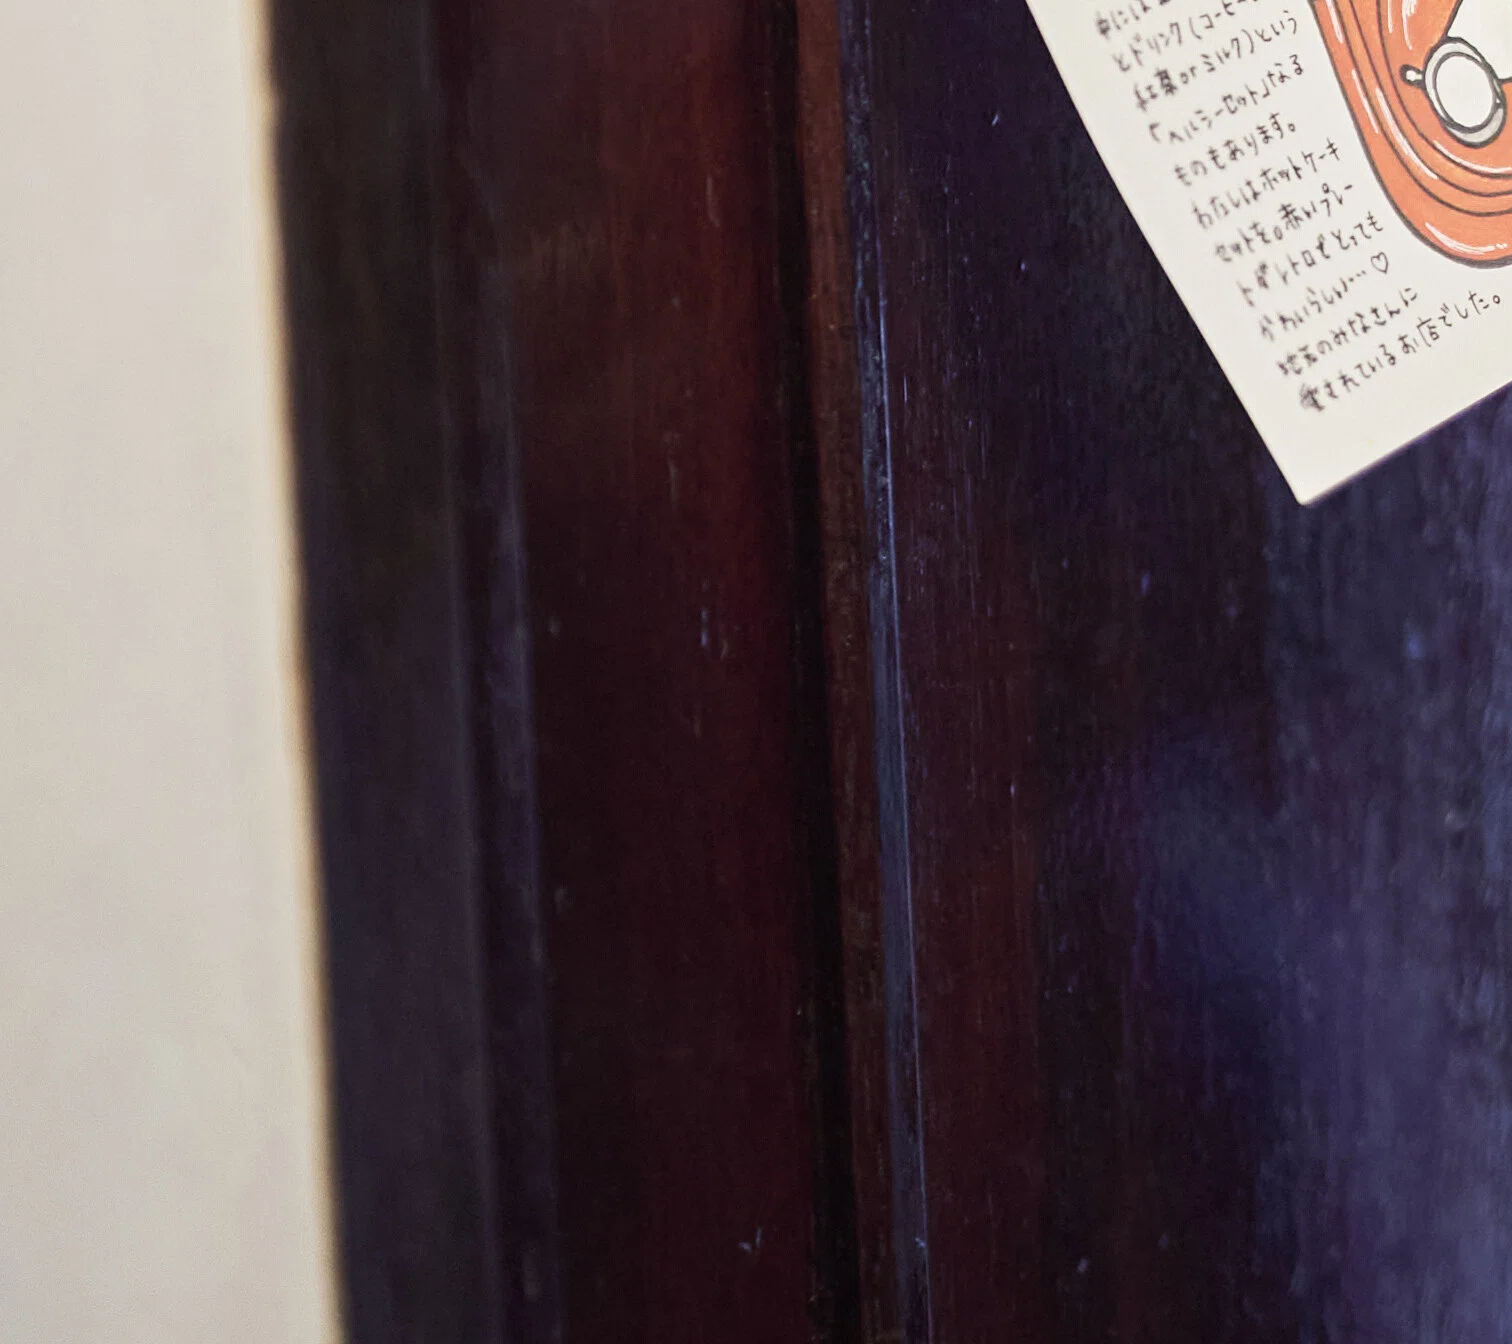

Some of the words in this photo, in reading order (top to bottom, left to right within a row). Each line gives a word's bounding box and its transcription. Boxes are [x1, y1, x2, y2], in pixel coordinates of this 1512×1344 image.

[1174, 113, 1296, 186] ものもあります。
